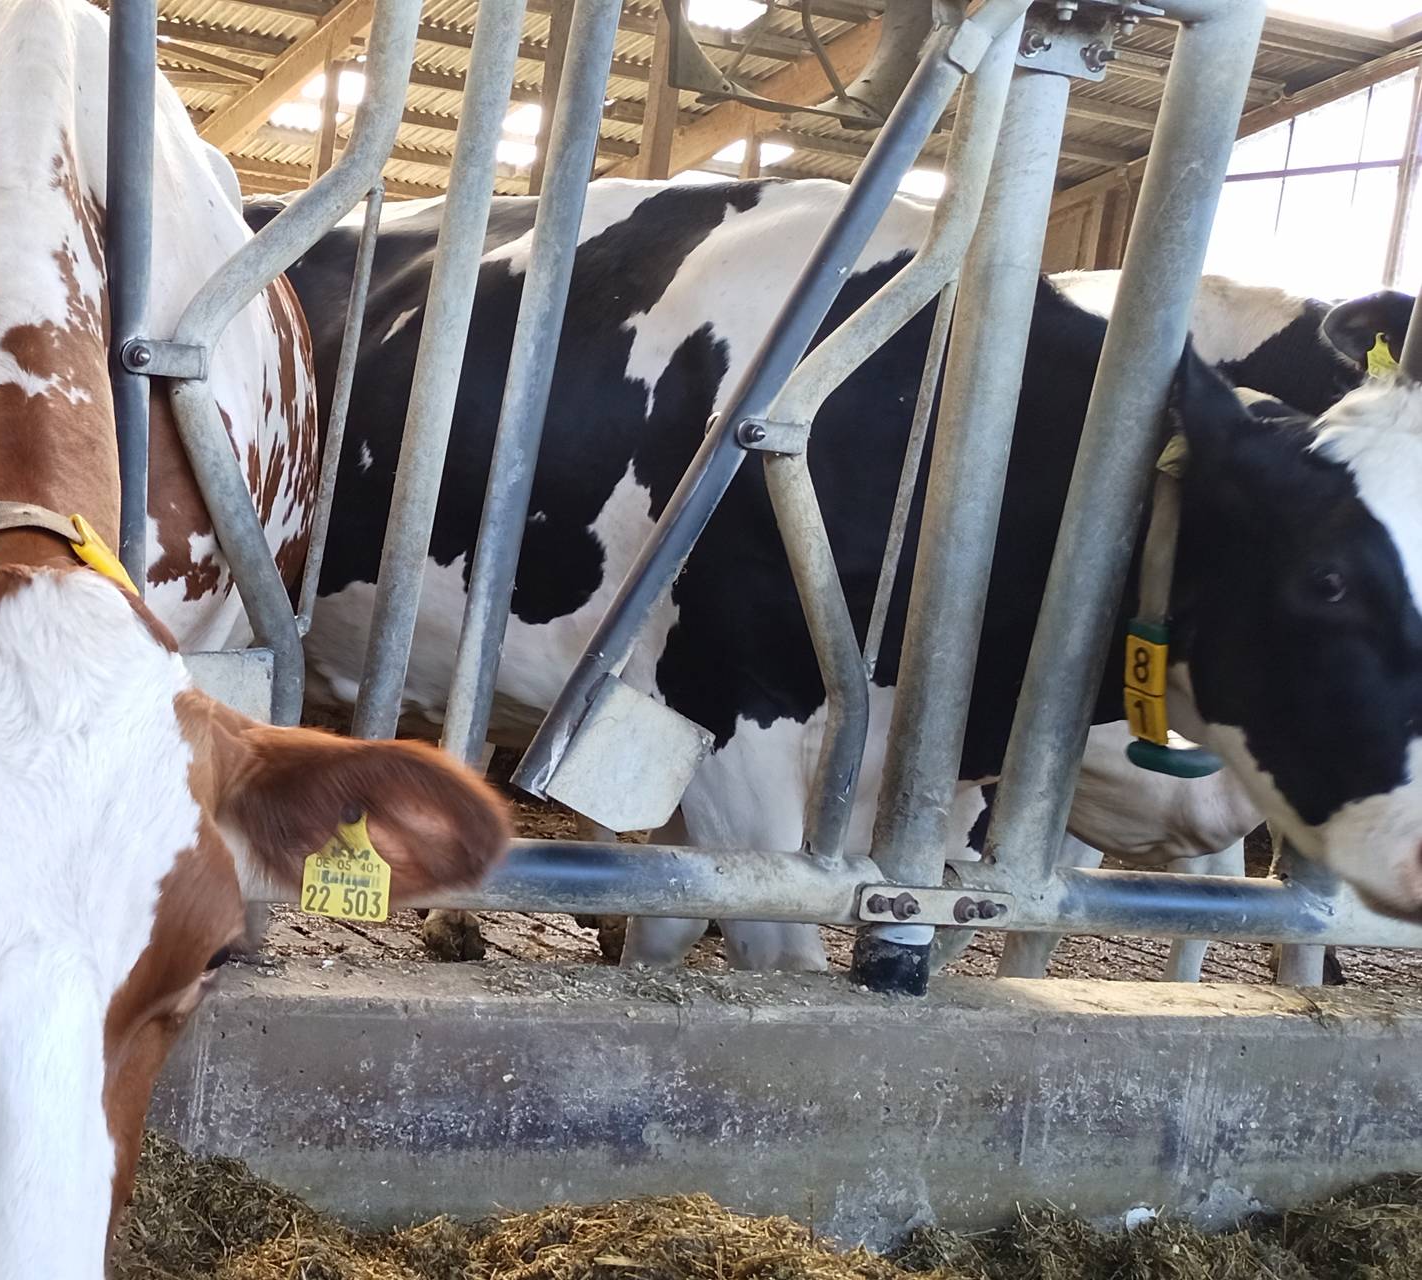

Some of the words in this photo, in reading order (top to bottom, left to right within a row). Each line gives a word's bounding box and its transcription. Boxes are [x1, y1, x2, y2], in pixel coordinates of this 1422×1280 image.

[1133, 646, 1150, 684] 8
[1134, 699, 1147, 735] 1
[315, 856, 331, 869] DE
[337, 859, 352, 871] 05
[360, 862, 381, 873] 401
[304, 883, 331, 913] 22
[341, 887, 382, 919] 503
